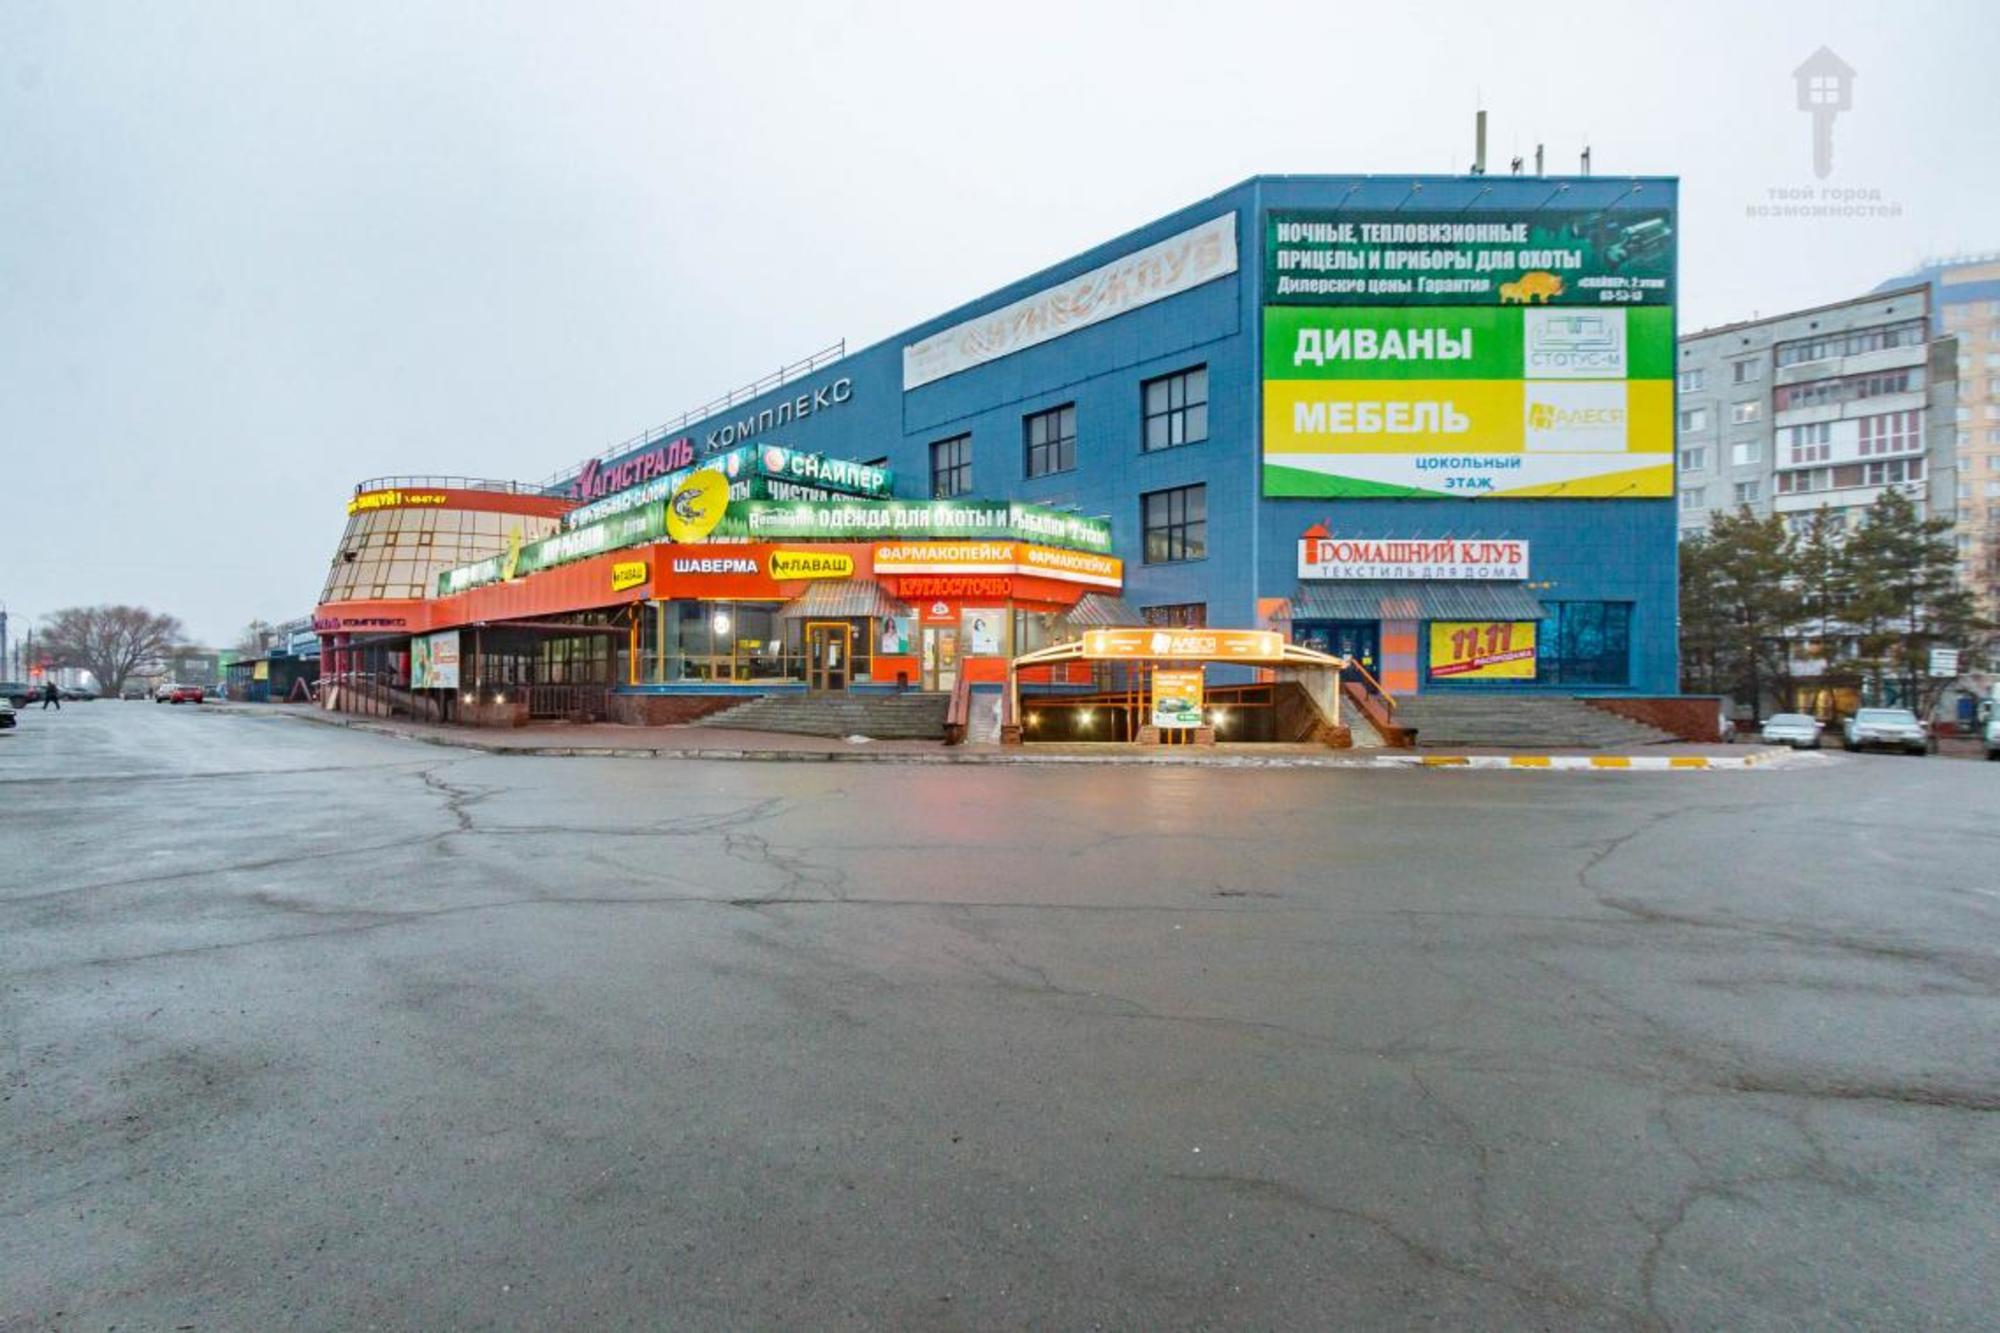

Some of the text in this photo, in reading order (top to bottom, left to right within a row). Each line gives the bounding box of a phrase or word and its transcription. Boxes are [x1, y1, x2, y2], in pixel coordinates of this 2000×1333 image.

[1277, 223, 1528, 244] НОЧНЫЕ, ТЕПЛОВИЗИОННЫЕ
[1277, 250, 1582, 272] ПРИЦЕЛЫ И ПРИБОРЫ ДЛЯ ОХОТЫ
[1277, 276, 1365, 294] Дилерские
[1417, 276, 1491, 294] Гарантия
[1294, 329, 1472, 366] ДИВАНЫ
[706, 378, 851, 450] КОМПЛЕКС
[1294, 402, 1470, 434] МЕБЕЛЬ
[791, 453, 884, 489] СНАЙПЕР
[1416, 456, 1521, 469] ЦОКОЛЬНЫЙ
[767, 480, 828, 502] ЧИСТКА
[819, 508, 890, 528] ОДЕЖДА
[894, 508, 928, 528] ДЛЯ
[879, 544, 1012, 560] ФАРМАКОПЕЙКА
[1028, 550, 1112, 574] ФАРМАКОПЕЙКА
[1461, 543, 1522, 563] КЛУБ
[673, 559, 758, 573] ШАВЕРМА
[1321, 566, 1519, 578] ТЕКСТИЛЬ ДЛЯ ДОМА
[900, 577, 1012, 597] КРУГЛОСУТОЧНО
[1451, 623, 1513, 661] 11.11
